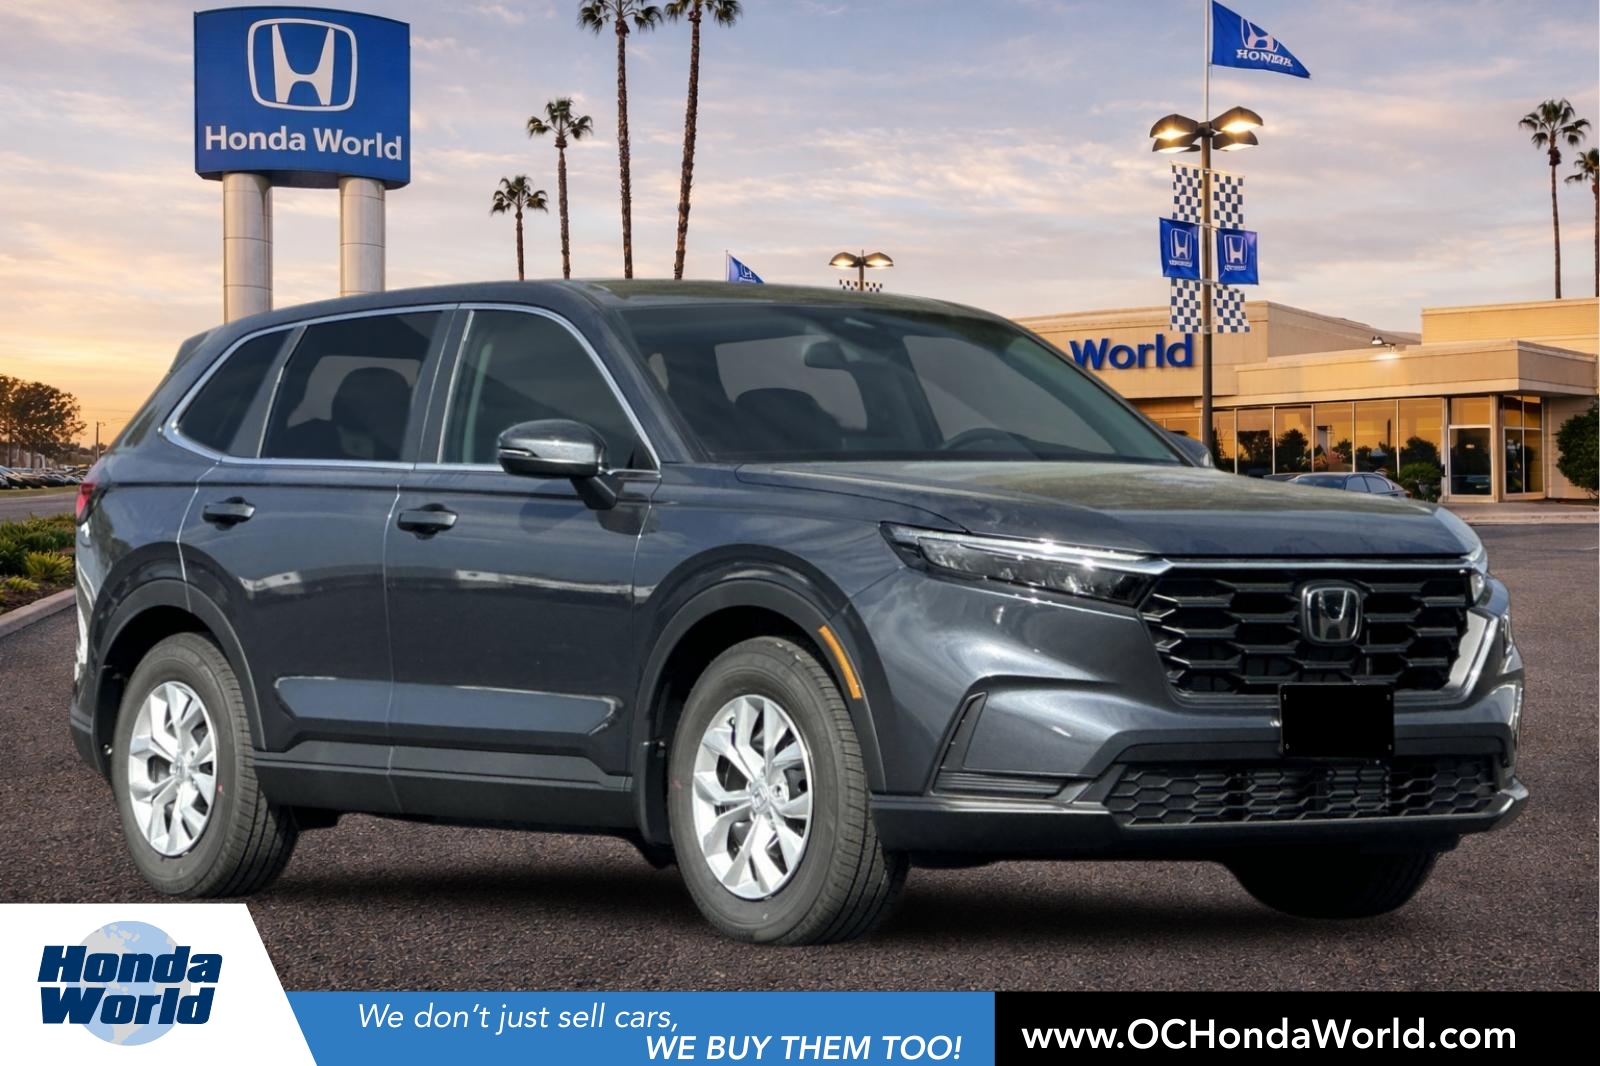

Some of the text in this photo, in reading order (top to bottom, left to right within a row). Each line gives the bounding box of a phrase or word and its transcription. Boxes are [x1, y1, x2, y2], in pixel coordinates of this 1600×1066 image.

[205, 125, 402, 161] Honda World
[1069, 333, 1194, 370] World
